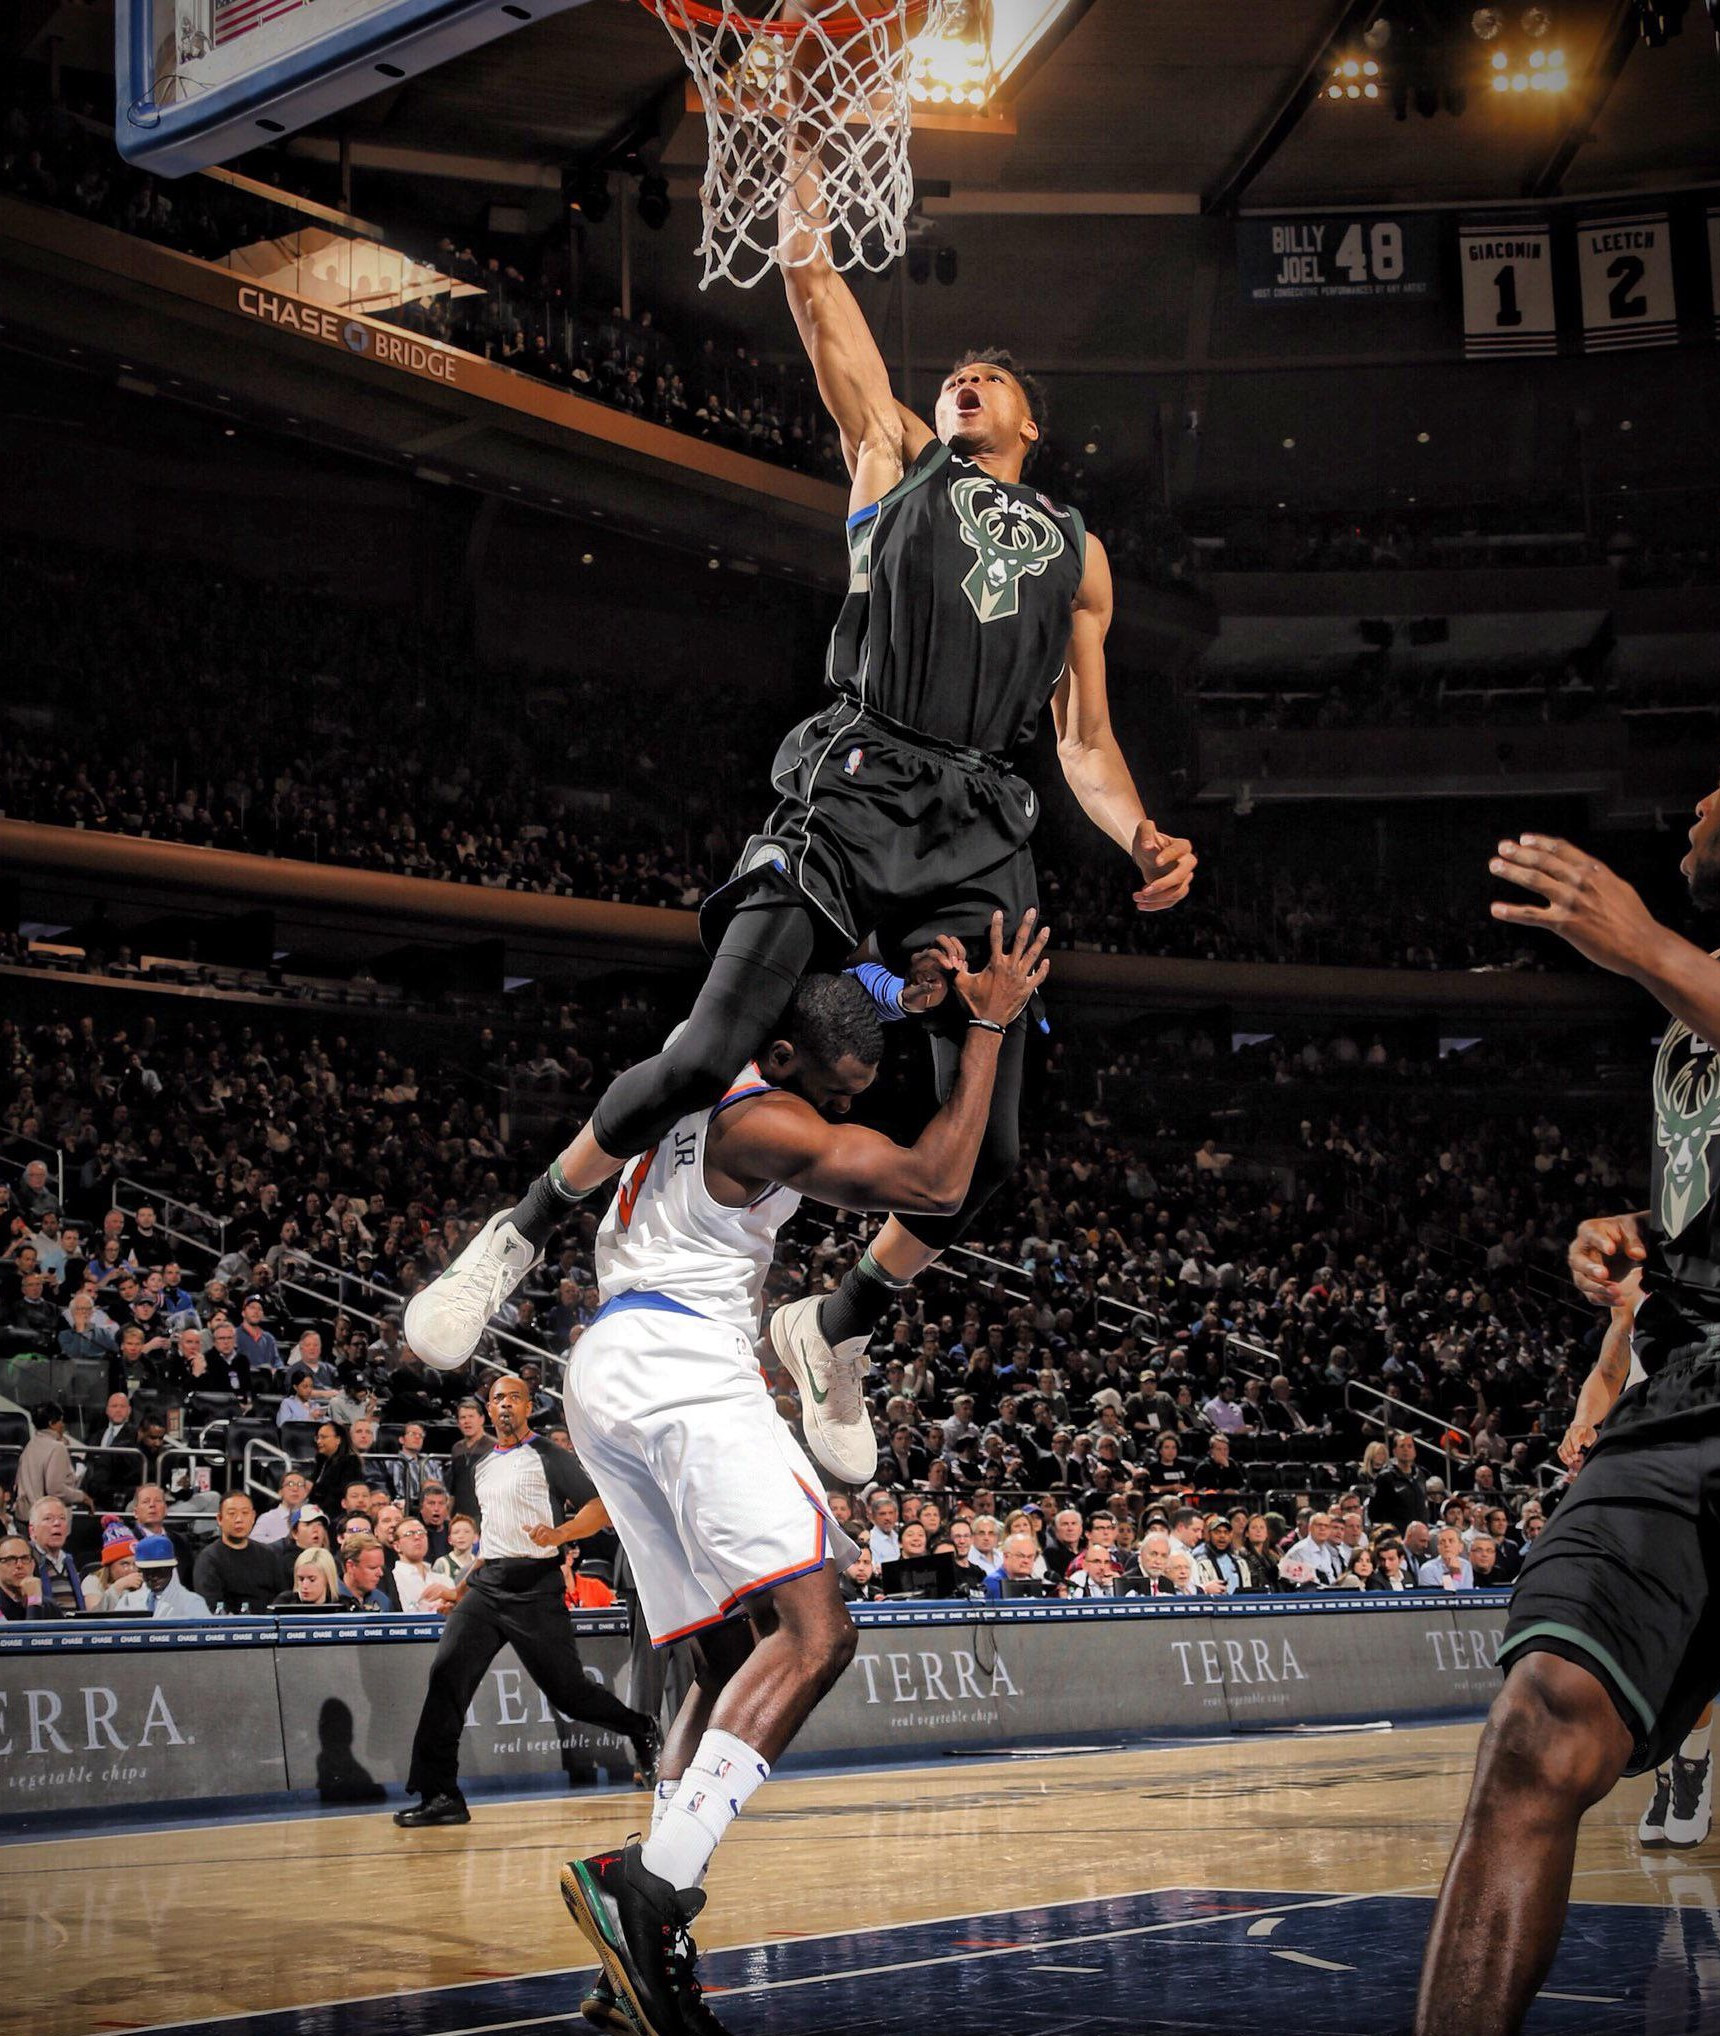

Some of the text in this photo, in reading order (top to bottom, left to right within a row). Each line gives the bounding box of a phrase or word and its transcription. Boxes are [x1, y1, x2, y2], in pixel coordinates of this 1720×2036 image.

[1272, 224, 1326, 254] BILLY
[1335, 221, 1404, 282] 48
[1469, 242, 1541, 261] GIACOMIN
[1591, 231, 1655, 255] LEETCH
[1276, 255, 1326, 284] JOEL
[1494, 265, 1522, 326] 1
[1607, 256, 1647, 319] 2
[238, 286, 457, 383] CHASE BRIDGE
[493, 1737, 520, 1754] real
[526, 1733, 590, 1755] vegetable
[9, 1763, 147, 1791] vegetable chips
